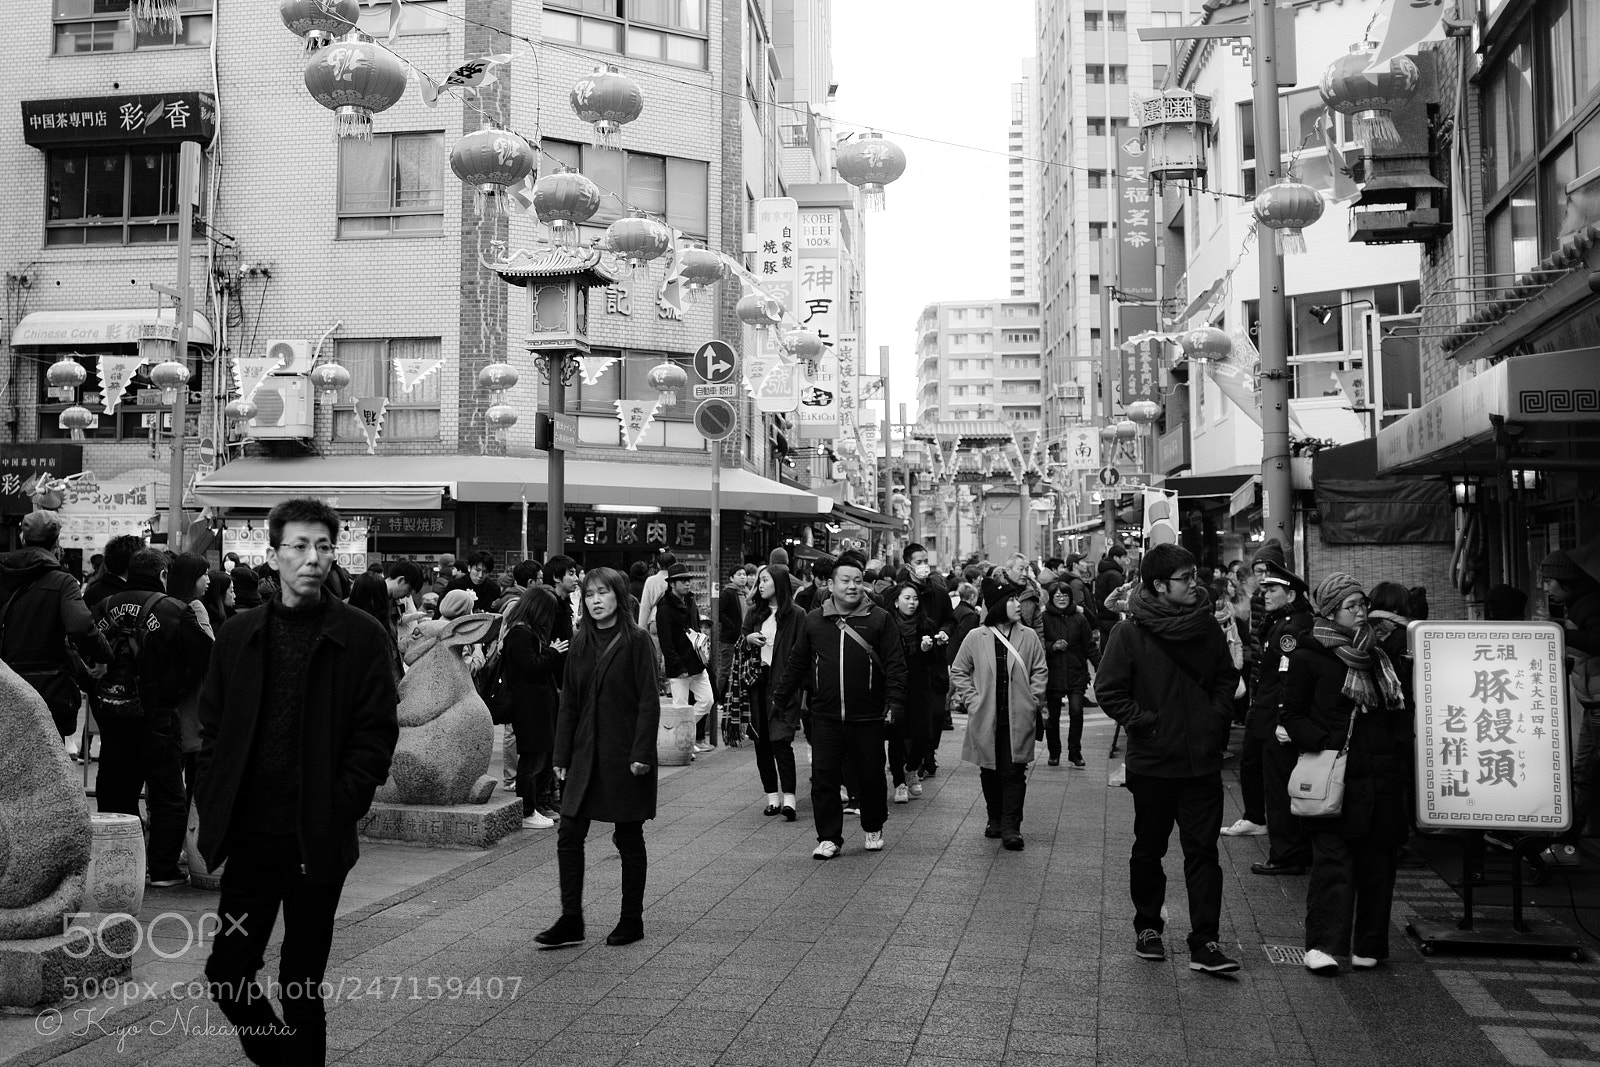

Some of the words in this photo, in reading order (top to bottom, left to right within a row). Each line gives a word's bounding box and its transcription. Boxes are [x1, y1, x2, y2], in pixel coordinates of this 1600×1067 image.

[30, 110, 107, 130] 中国茶専門店
[803, 214, 834, 224] KOBE
[803, 226, 834, 236] BEEF
[782, 226, 793, 269] 自家製
[806, 238, 831, 246] 100%
[763, 240, 778, 275] 焼豚
[23, 328, 68, 340] Chinese
[70, 328, 100, 339] Cafe
[84, 394, 99, 404] Sale
[1075, 441, 1091, 457] 南
[2, 457, 56, 467] 中国茶専門店
[1, 473, 20, 496] 彩
[388, 517, 444, 532] 特製焼豚
[1472, 644, 1518, 662] 元祖
[1514, 668, 1525, 690] ぶた
[1528, 658, 1546, 740] 創業大正四年
[1469, 668, 1520, 789] 豚饅頭
[1515, 712, 1526, 734] まん
[1439, 704, 1470, 798] 老祥記
[1518, 750, 1526, 782] じゅう
